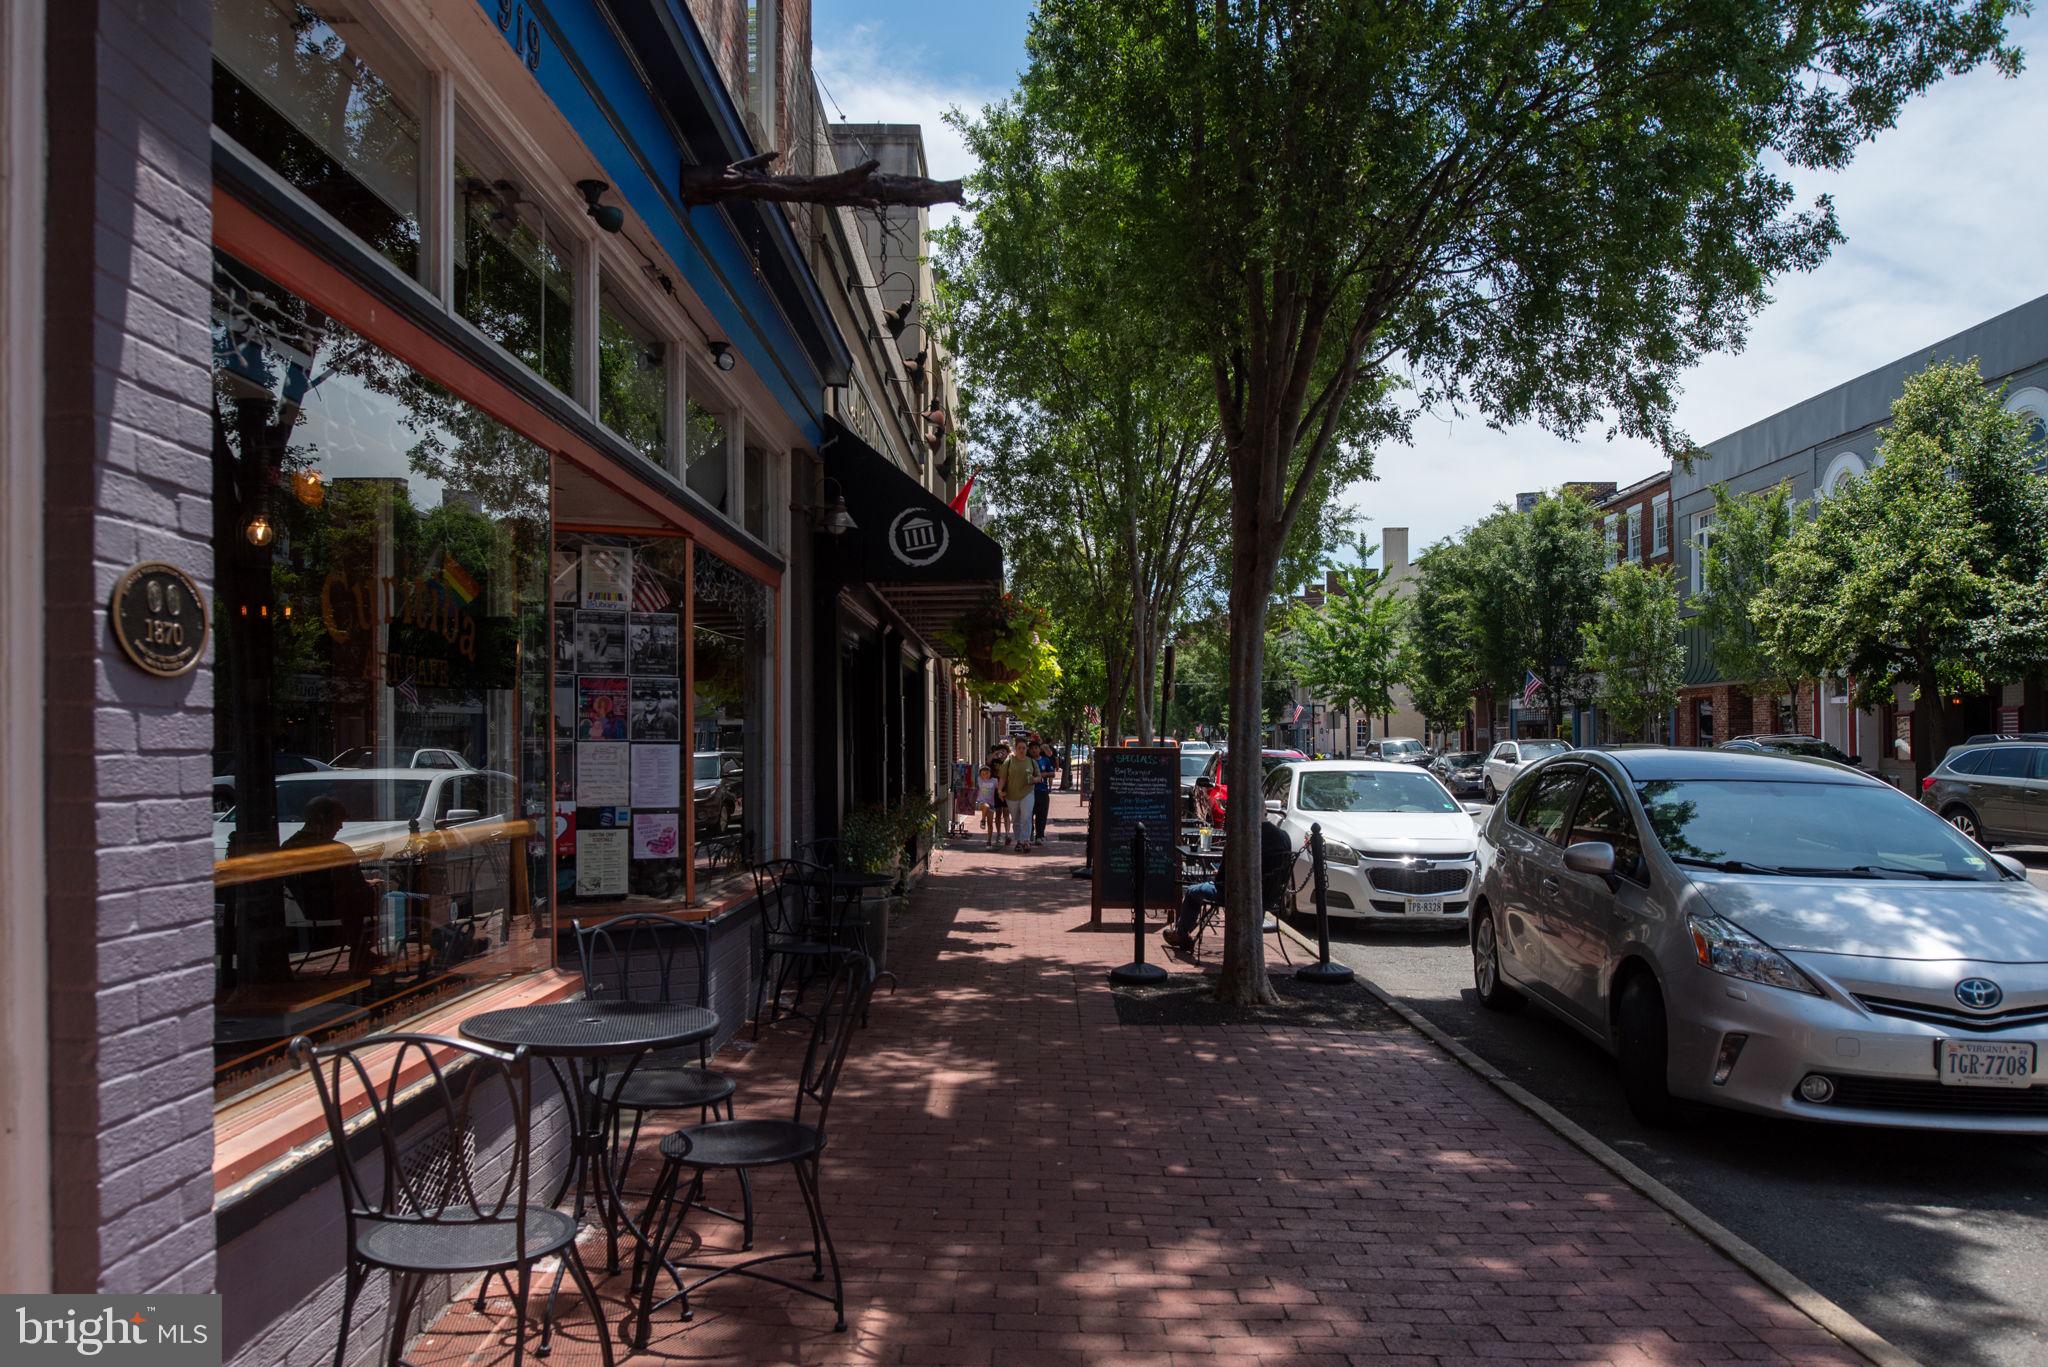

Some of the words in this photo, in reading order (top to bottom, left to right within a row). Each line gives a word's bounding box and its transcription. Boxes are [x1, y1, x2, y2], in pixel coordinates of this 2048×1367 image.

[144, 618, 184, 647] 1870
[1967, 1043, 2009, 1054] VIRGINIA
[1949, 1053, 2027, 1075] TGR-7708
